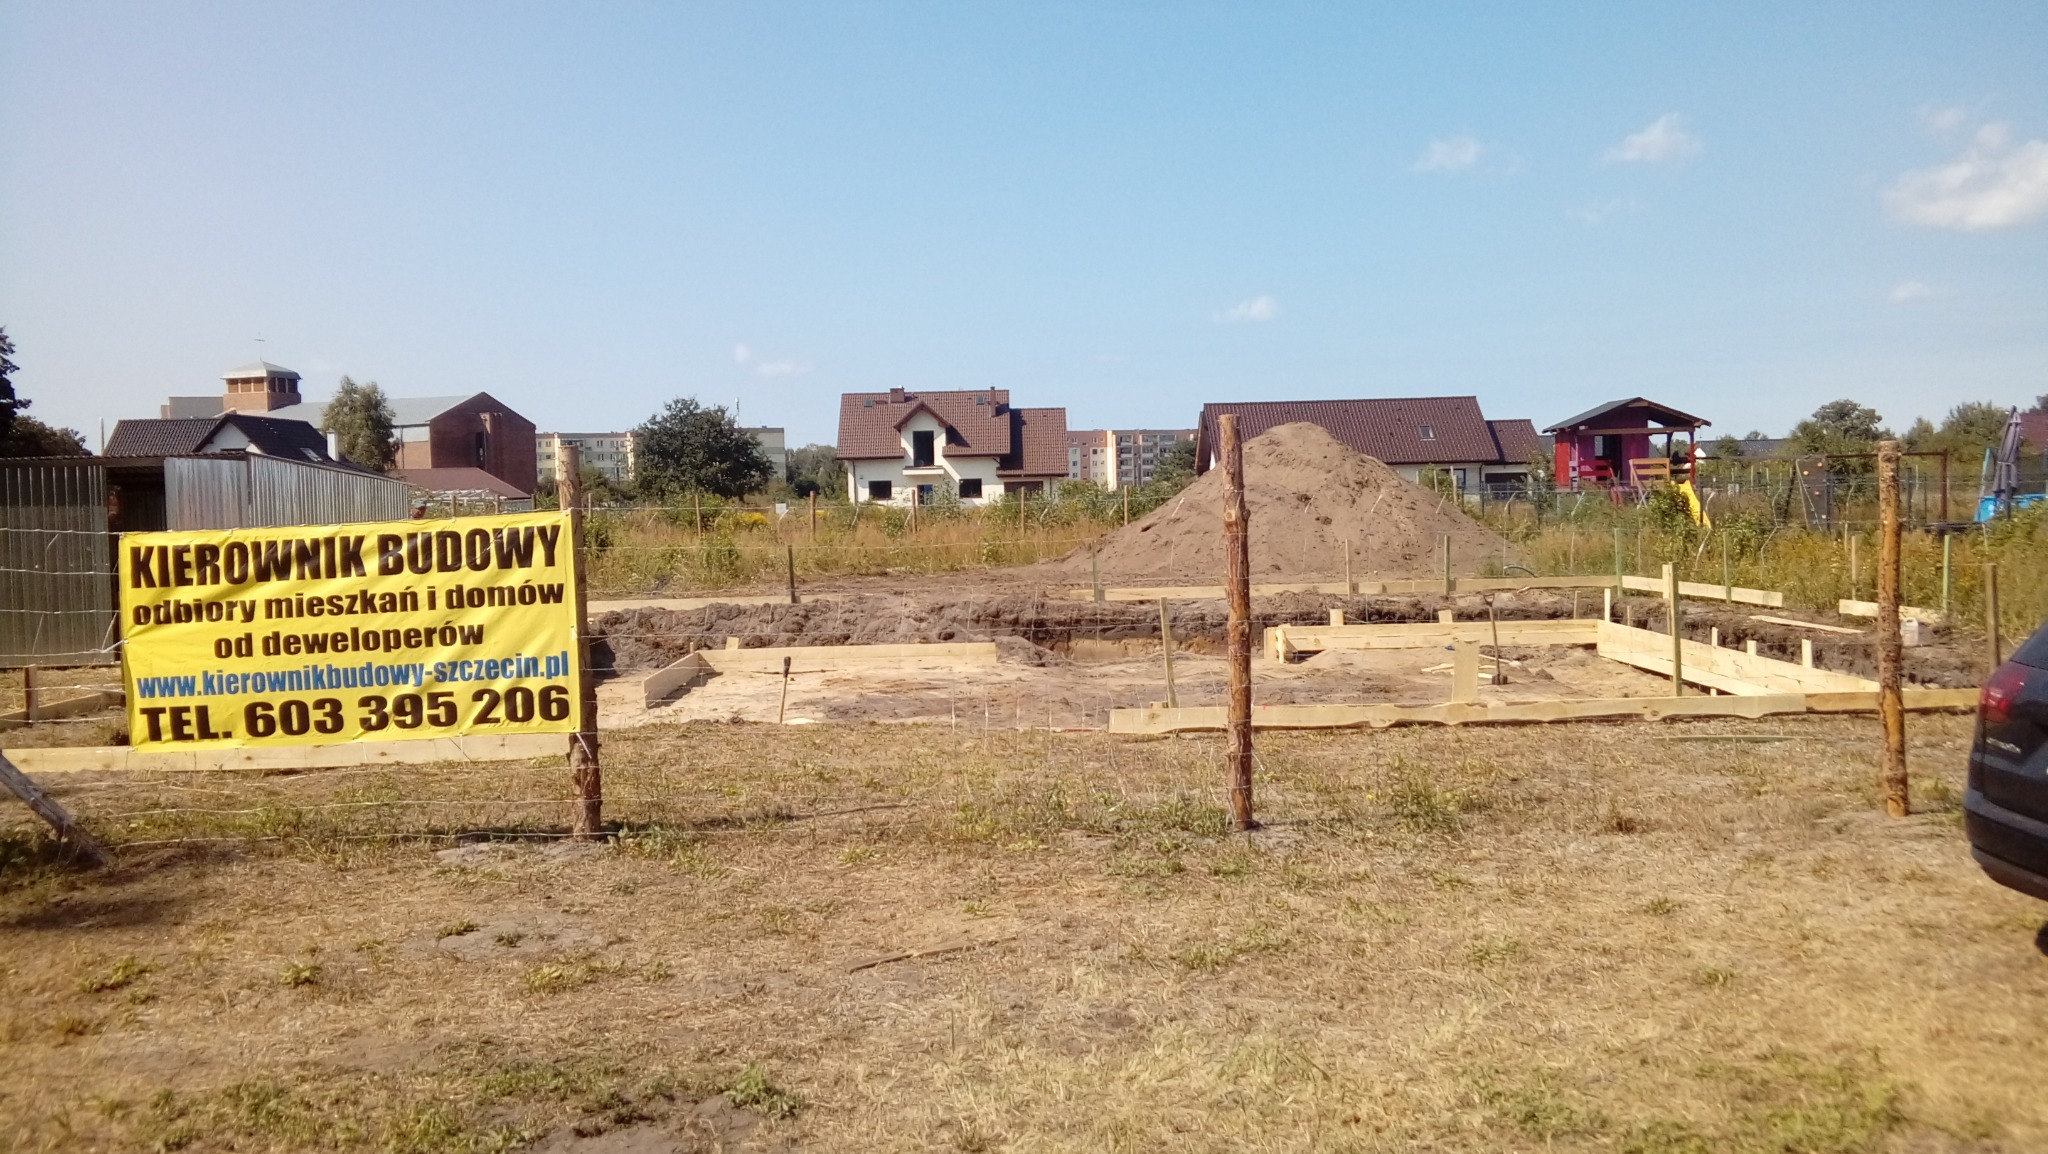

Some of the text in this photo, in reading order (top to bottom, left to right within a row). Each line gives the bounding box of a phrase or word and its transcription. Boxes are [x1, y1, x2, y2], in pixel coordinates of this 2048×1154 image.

[130, 525, 560, 588] KIEROWNIK BUDOWY
[133, 579, 564, 625] odbiory mieszkań i domów
[214, 621, 484, 658] od deweloperów
[137, 651, 568, 698] www.kierownikbudowy-szczecin.pl
[139, 685, 569, 741] TEL. 603 395 206
